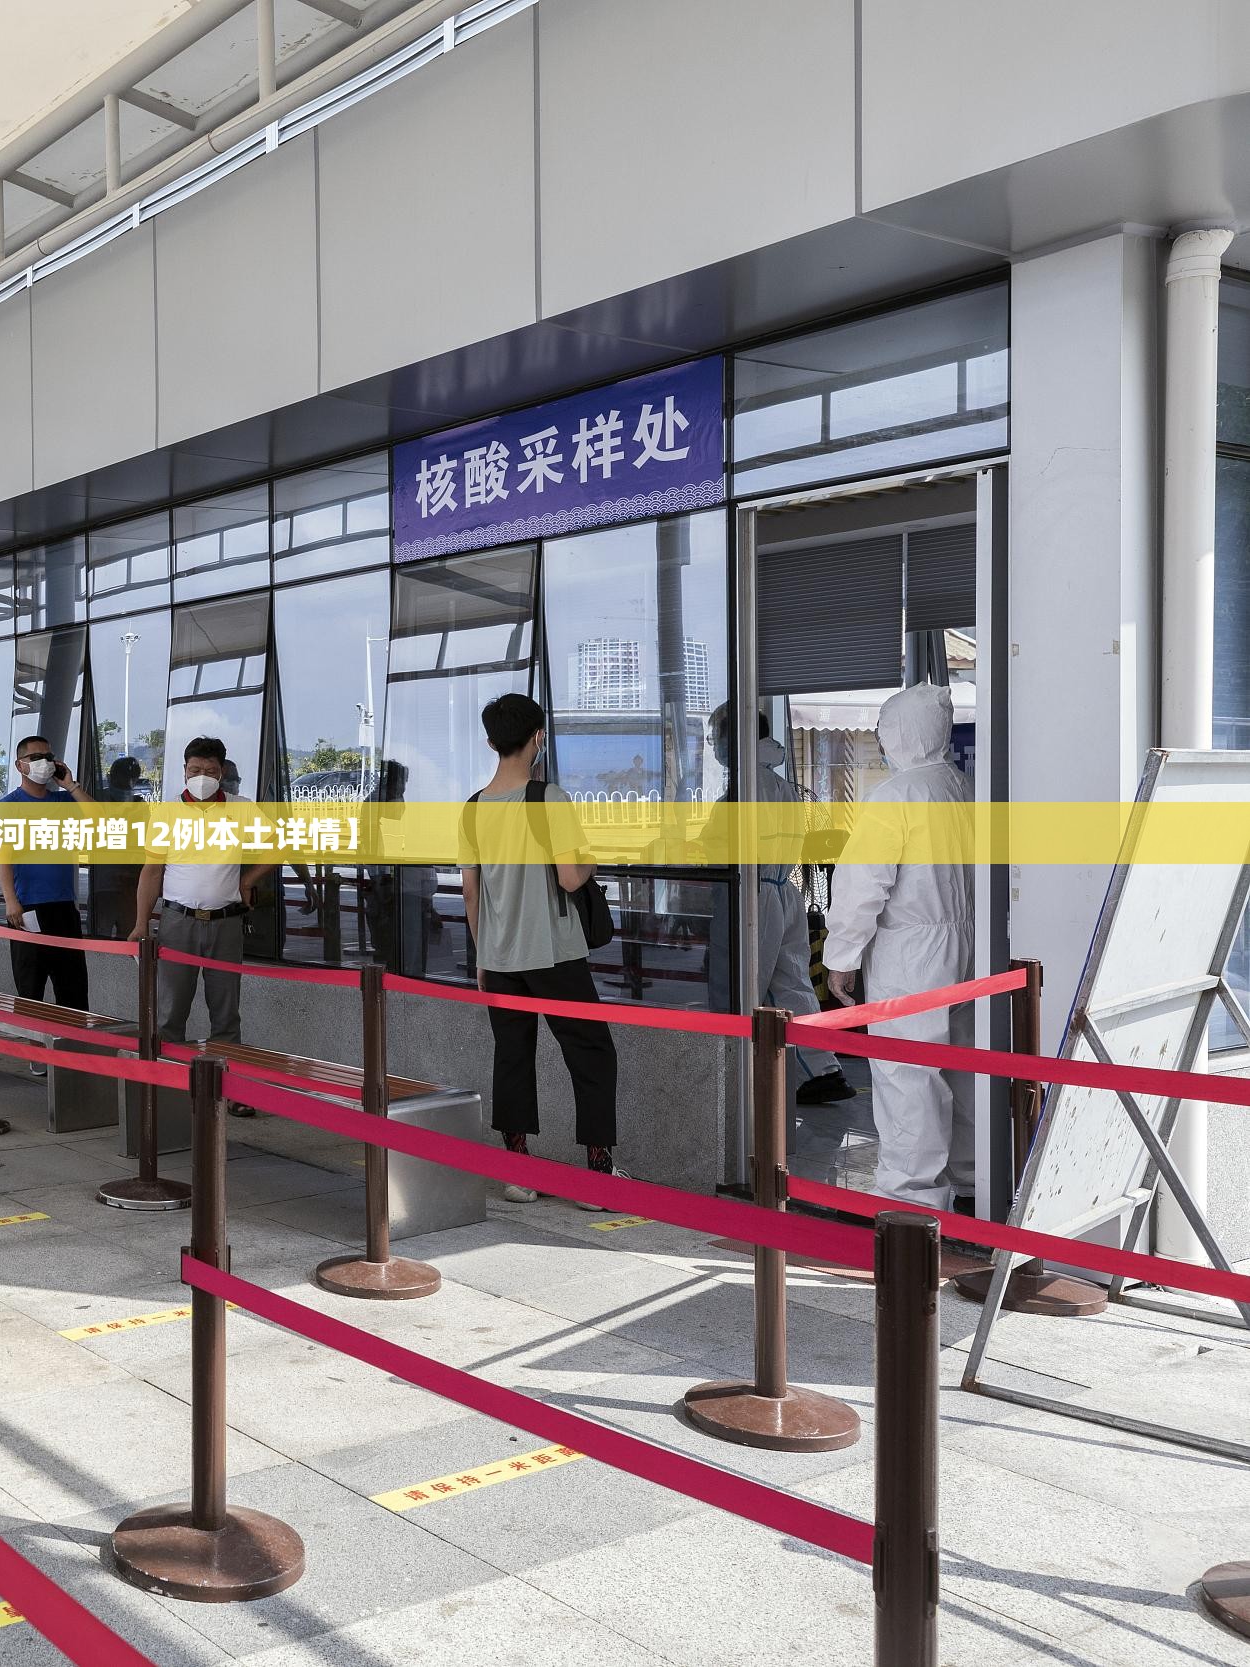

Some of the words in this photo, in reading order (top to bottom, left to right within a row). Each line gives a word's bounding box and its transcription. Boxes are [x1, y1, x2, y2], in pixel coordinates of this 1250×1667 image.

[415, 395, 690, 518] 核酸采样处
